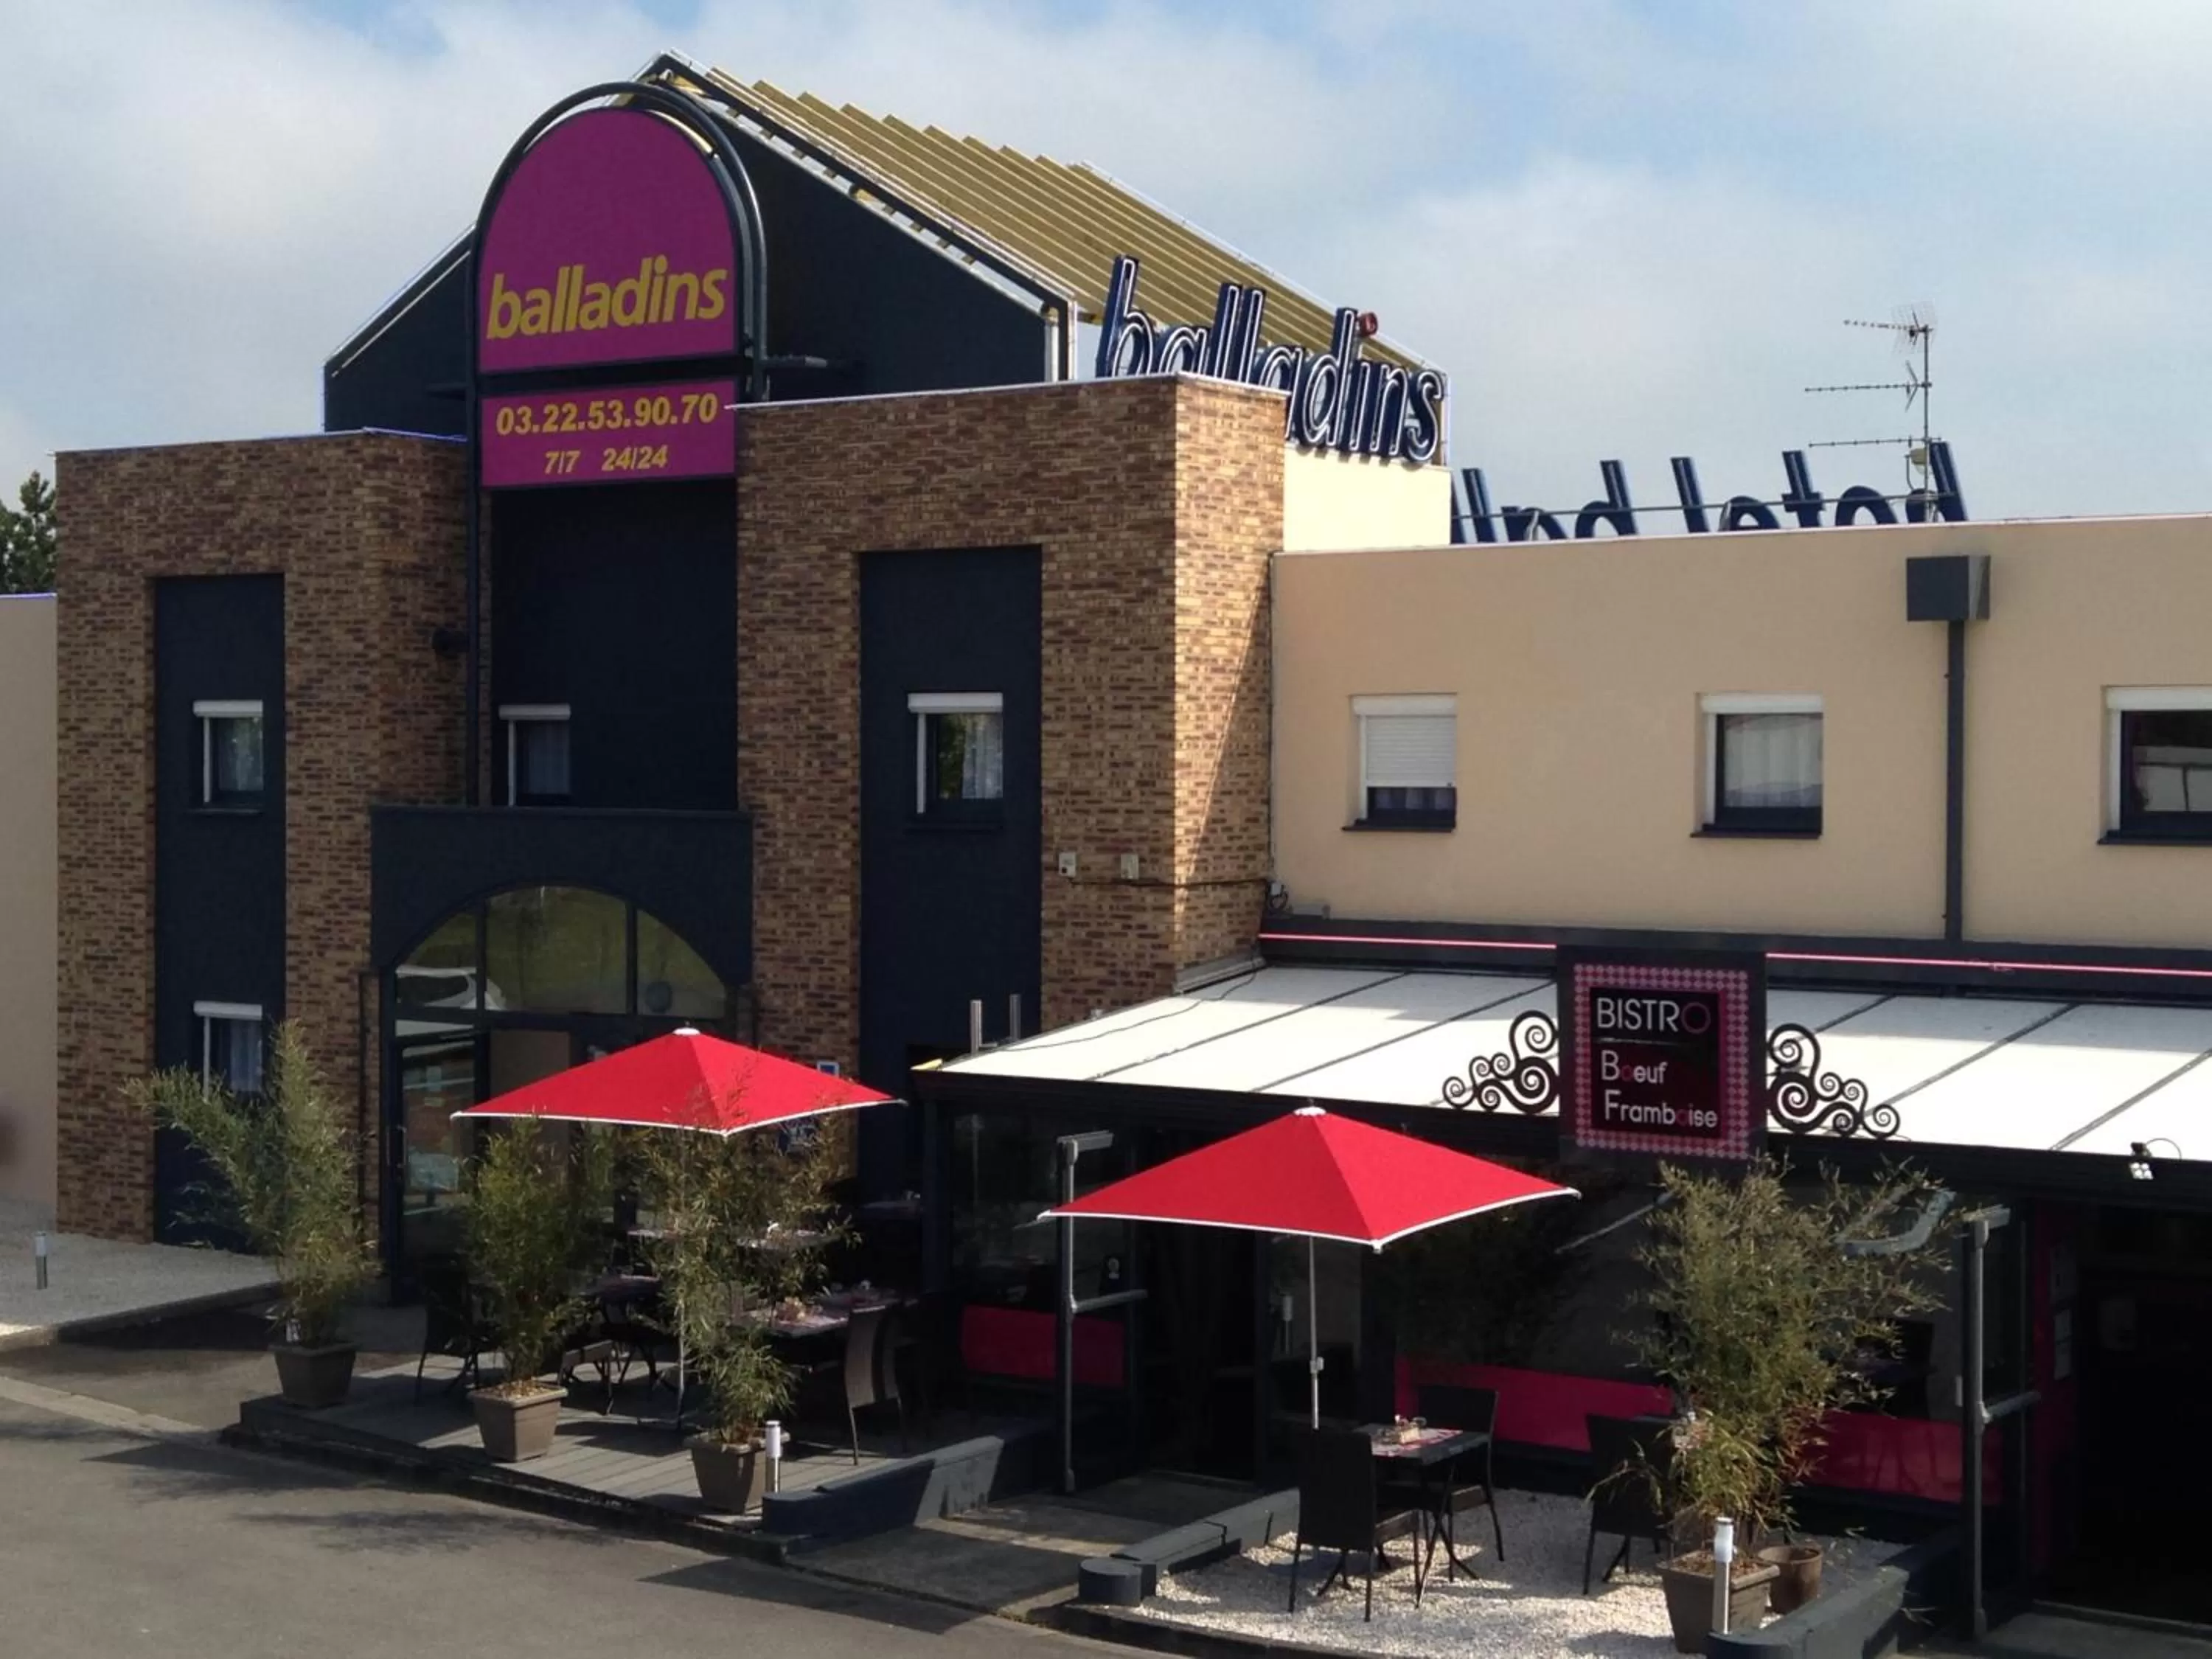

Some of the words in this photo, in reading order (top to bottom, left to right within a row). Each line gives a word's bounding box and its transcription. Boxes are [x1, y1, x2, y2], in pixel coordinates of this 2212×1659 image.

[487, 254, 728, 341] balladins
[495, 393, 719, 436] 03.22.53.90.70
[1596, 997, 1711, 1034] BISTRO
[1604, 1089, 1719, 1128] Framboise
